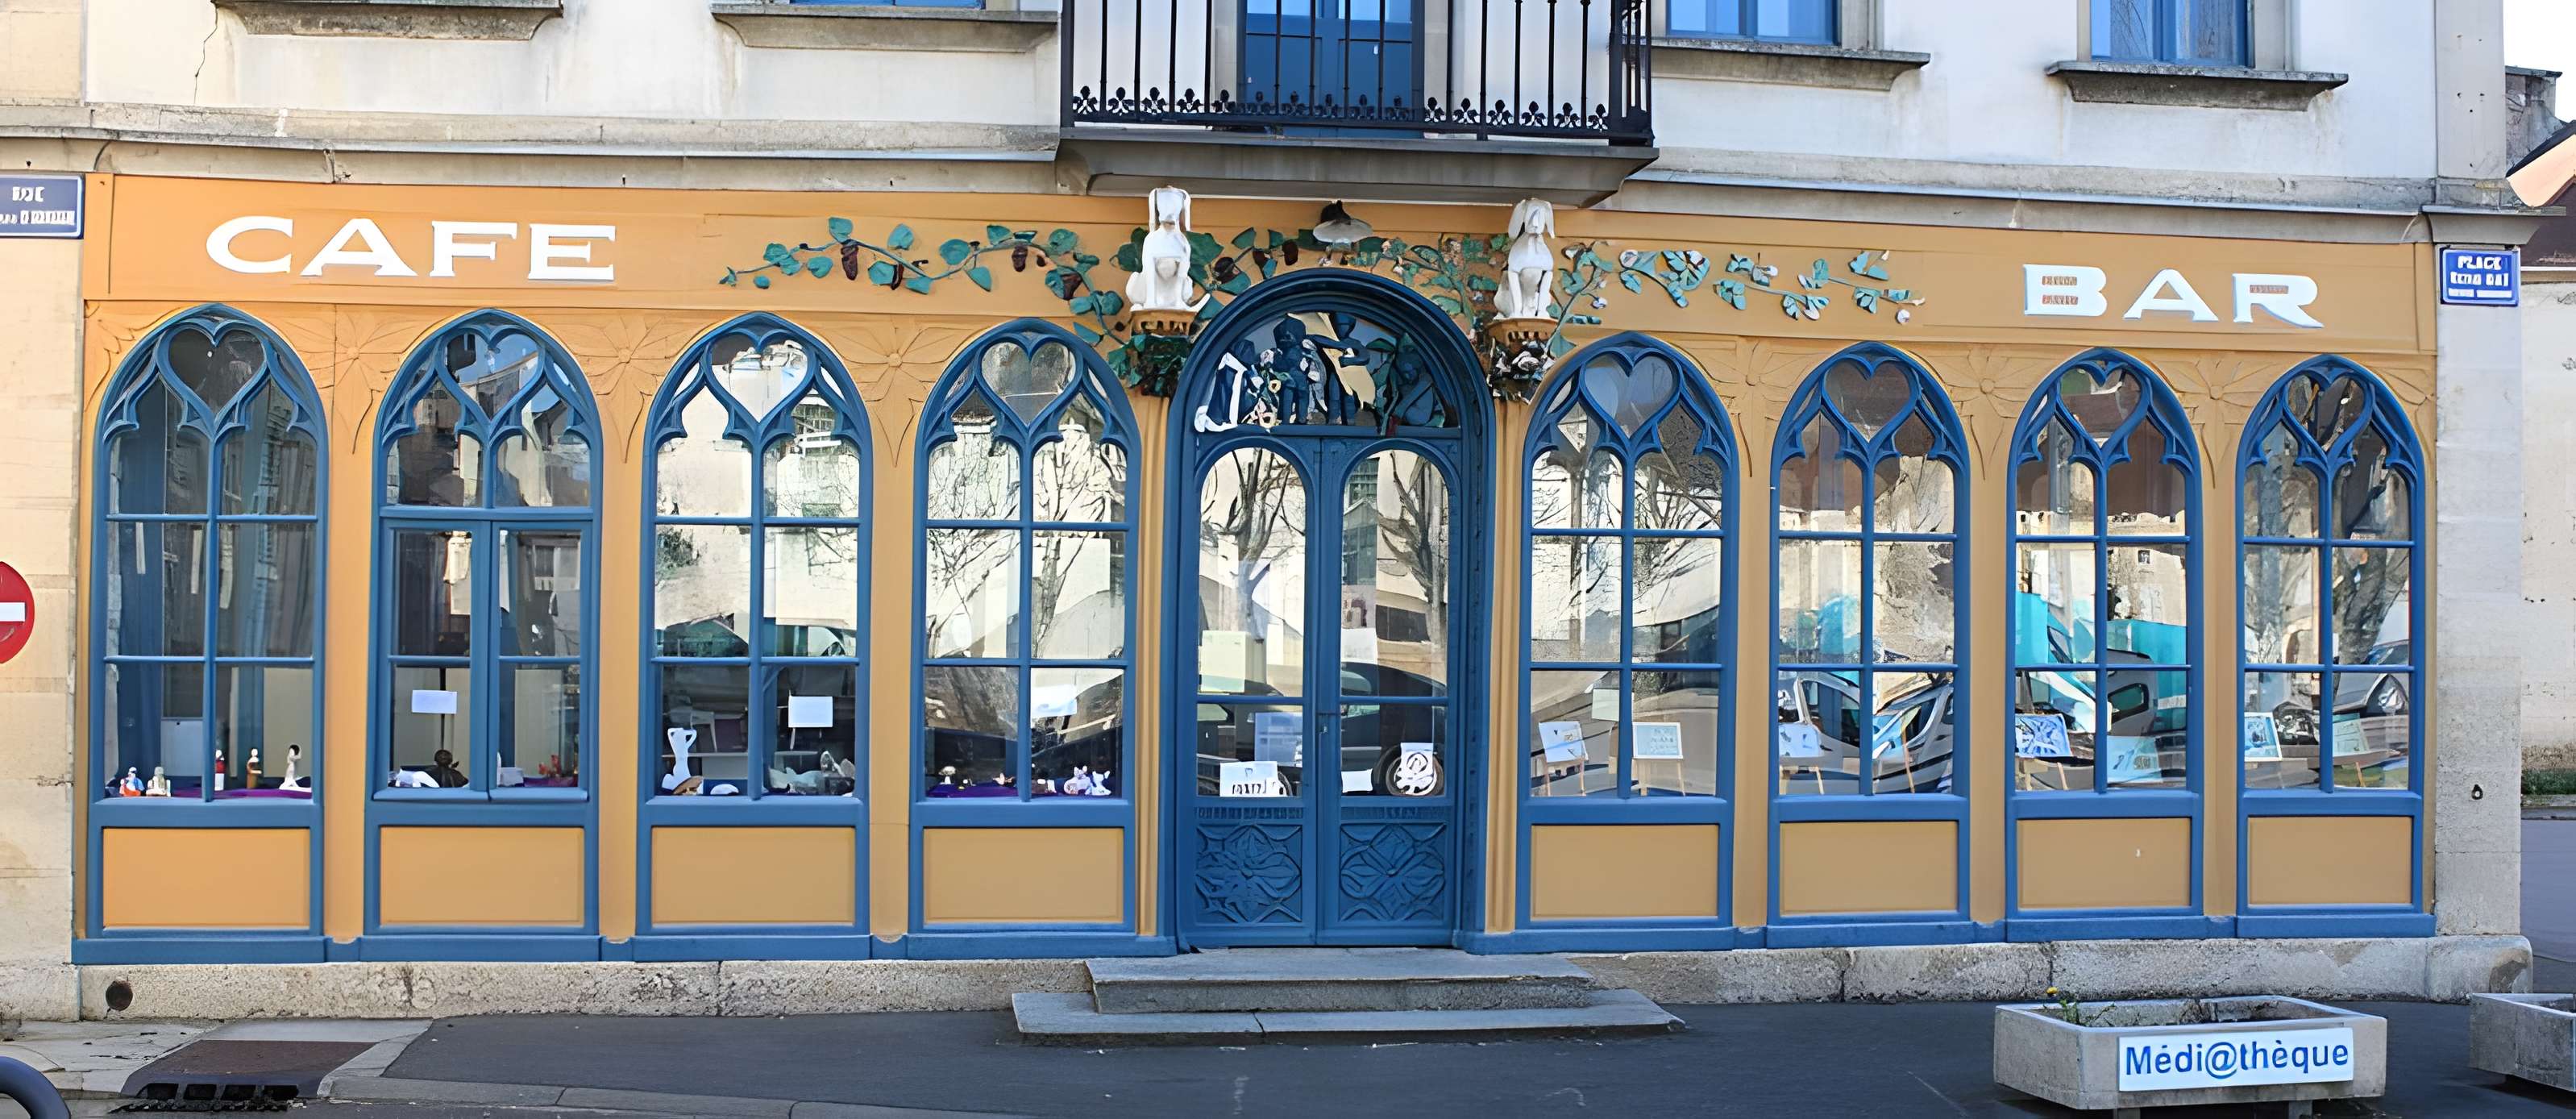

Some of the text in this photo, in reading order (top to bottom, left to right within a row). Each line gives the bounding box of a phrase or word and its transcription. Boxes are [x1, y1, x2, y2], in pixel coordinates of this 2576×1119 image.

[206, 215, 617, 281] CAFE
[2022, 264, 2324, 328] BAR
[2125, 1039, 2349, 1079] Médi@thèque
